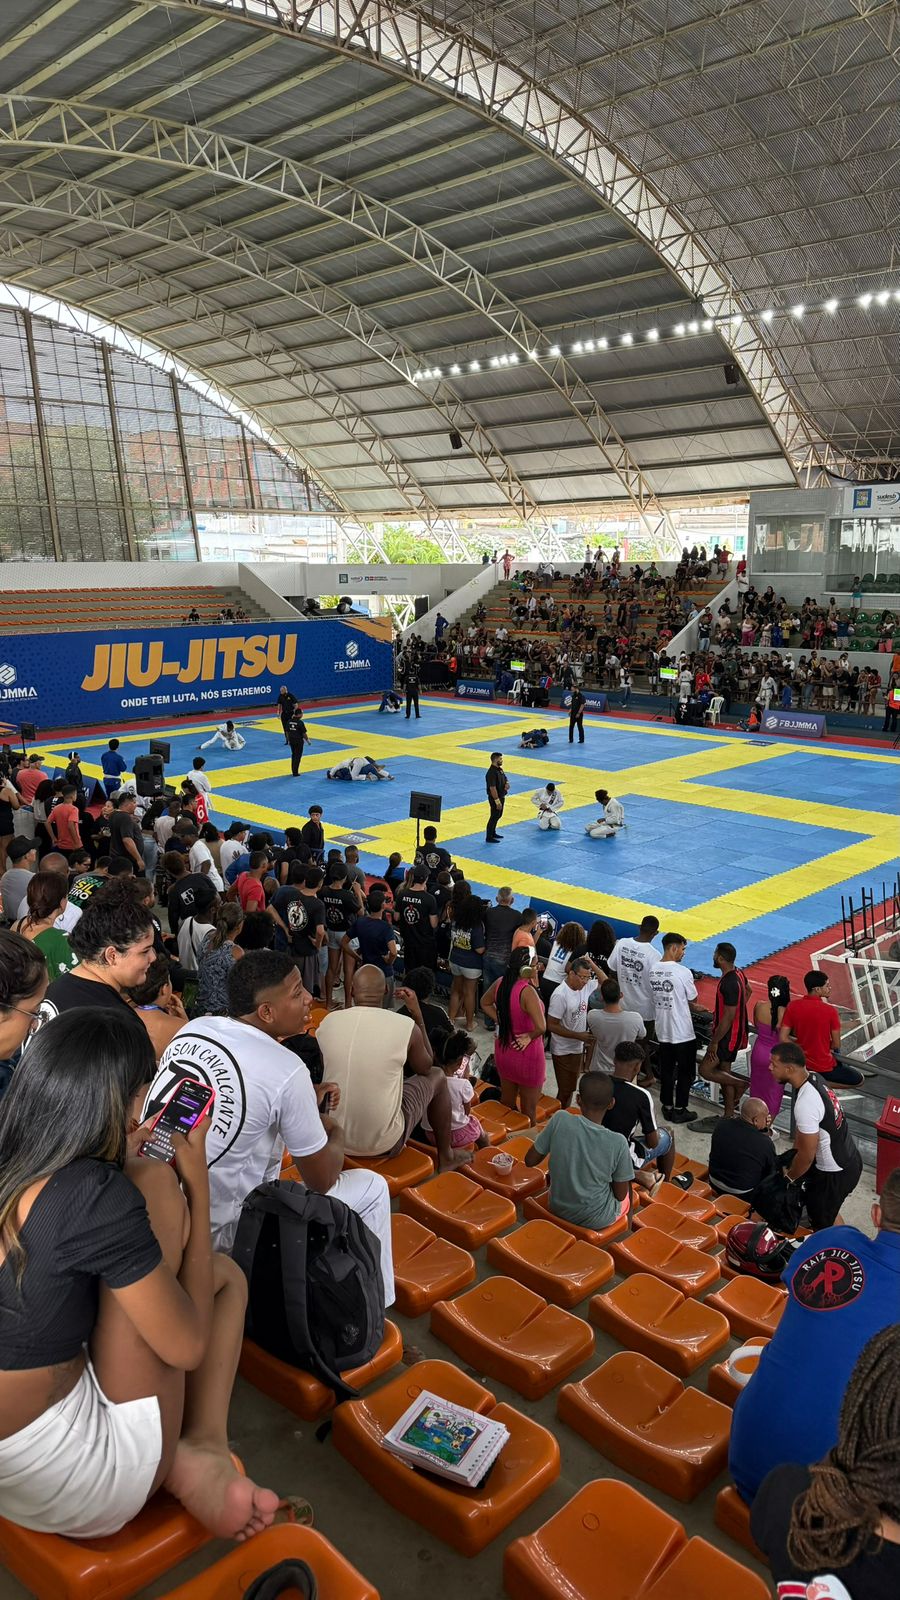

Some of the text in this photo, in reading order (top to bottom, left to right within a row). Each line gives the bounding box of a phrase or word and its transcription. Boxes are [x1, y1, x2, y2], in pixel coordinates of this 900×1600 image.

[80, 633, 298, 692] JIU-JITSU
[334, 659, 371, 670] FBJJMMA
[0, 686, 38, 699] JMMA
[121, 685, 272, 708] ONDE TEM LUTA, NÓS ESTAREMOS
[779, 719, 818, 730] FBJJMMA
[197, 804, 205, 820] 6
[323, 896, 343, 905] ATLETA
[402, 896, 422, 905] ATLETA
[198, 1048, 235, 1139] CAVALCANTE
[802, 1249, 863, 1292] RAIZ JIU JITSU
